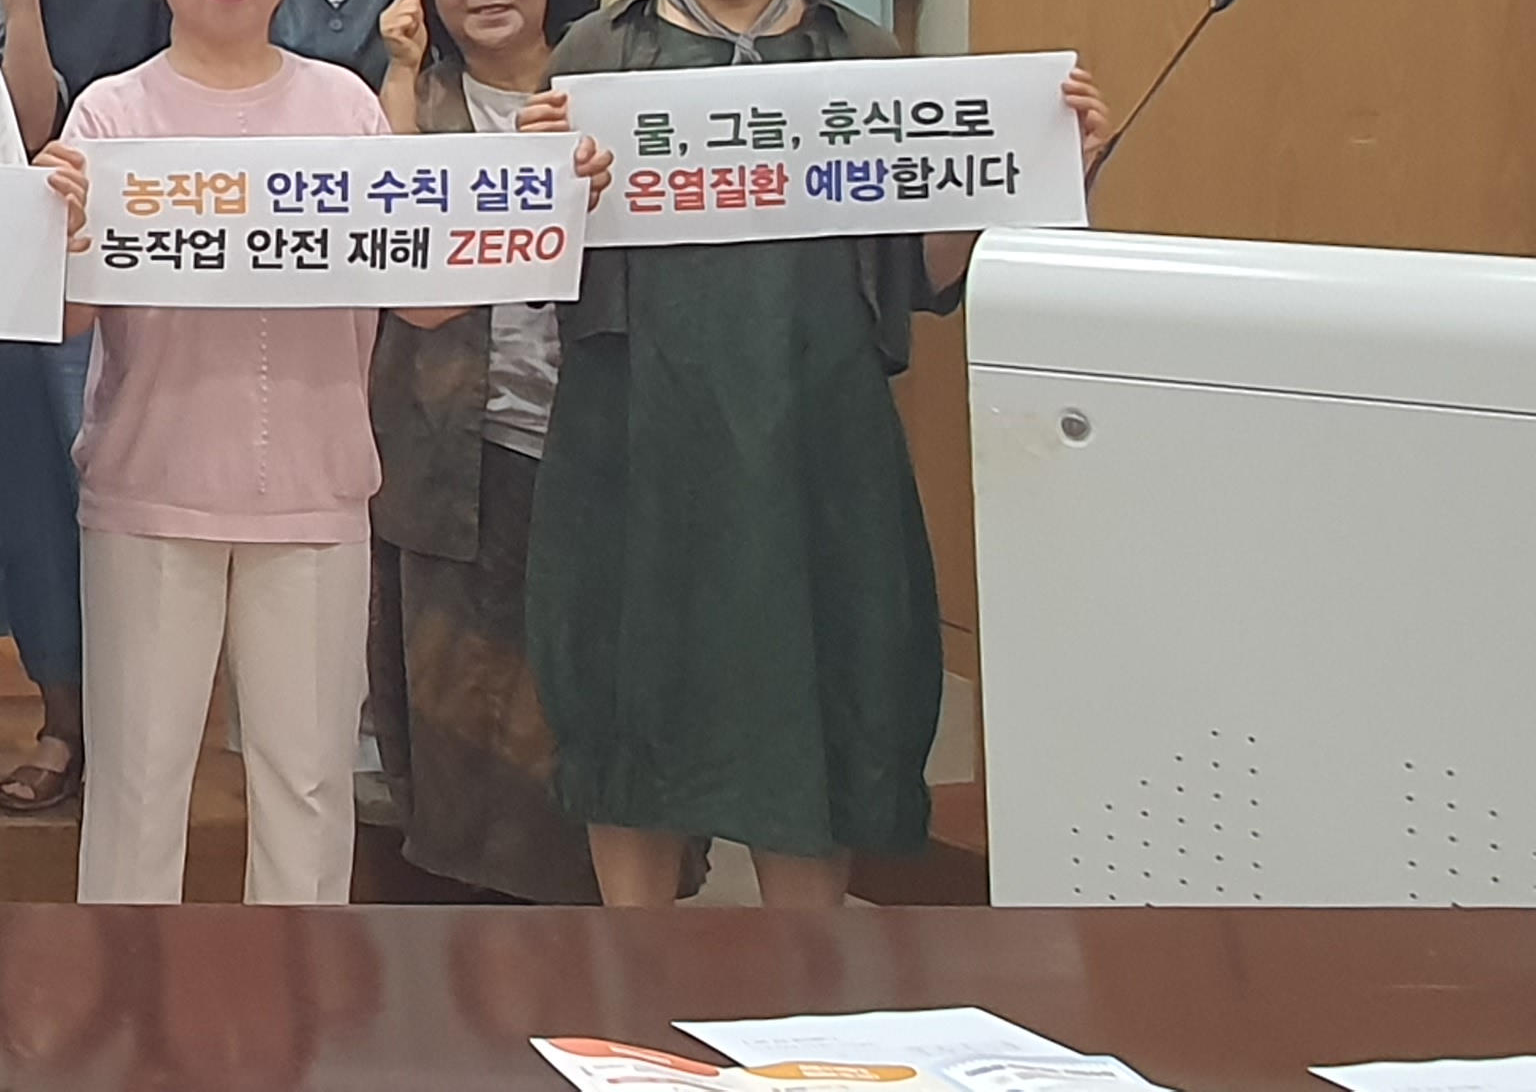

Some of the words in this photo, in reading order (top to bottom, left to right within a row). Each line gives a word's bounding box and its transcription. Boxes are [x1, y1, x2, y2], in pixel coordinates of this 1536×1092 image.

[633, 112, 689, 157] 물,
[706, 107, 802, 151] 그늘,
[819, 99, 995, 145] 휴식으로
[122, 171, 249, 216] 농작업
[267, 170, 350, 213] 안전
[368, 168, 449, 213] 수칙
[470, 166, 554, 212] 실천
[624, 162, 789, 213] 온열질환
[805, 152, 1020, 202] 예방합시다
[100, 228, 227, 270] 농작업
[246, 228, 329, 269] 안전
[348, 227, 430, 270] 재해
[446, 225, 565, 266] ZERO
